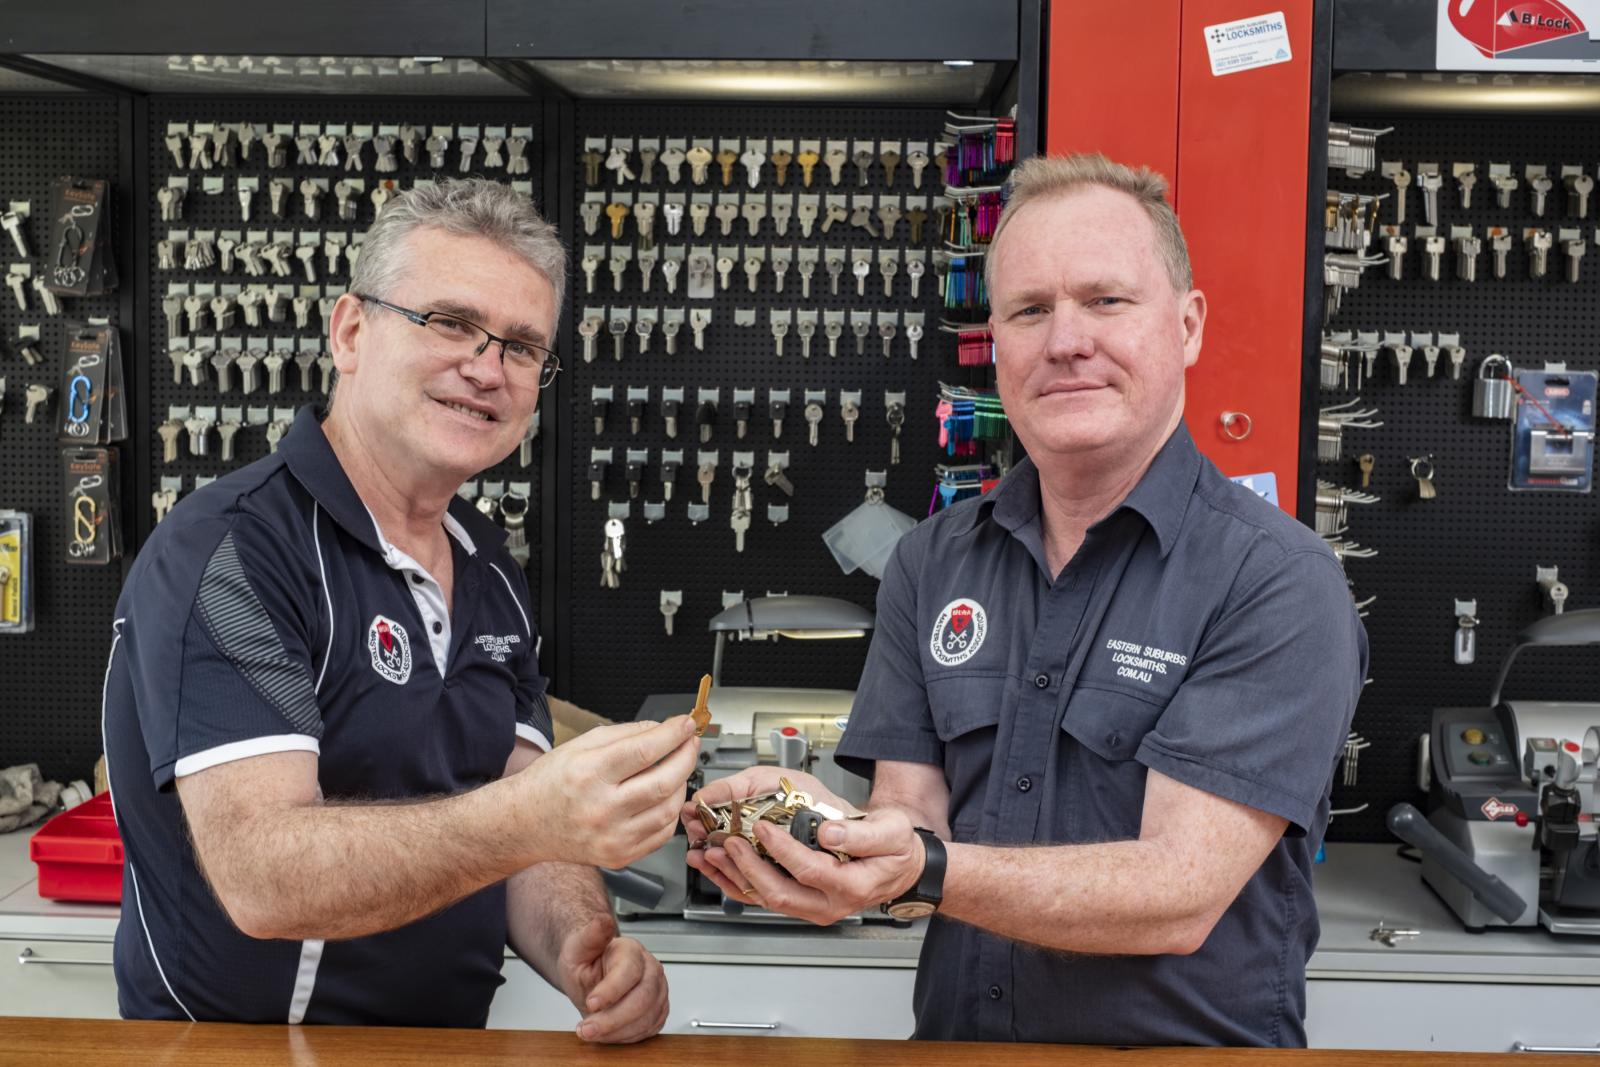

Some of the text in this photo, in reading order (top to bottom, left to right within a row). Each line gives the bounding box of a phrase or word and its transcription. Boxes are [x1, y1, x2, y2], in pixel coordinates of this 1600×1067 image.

[1226, 22, 1283, 40] LOCKSMITHS
[1106, 639, 1187, 666] EASTERN SUBURBS
[1117, 666, 1153, 683] COM.AU
